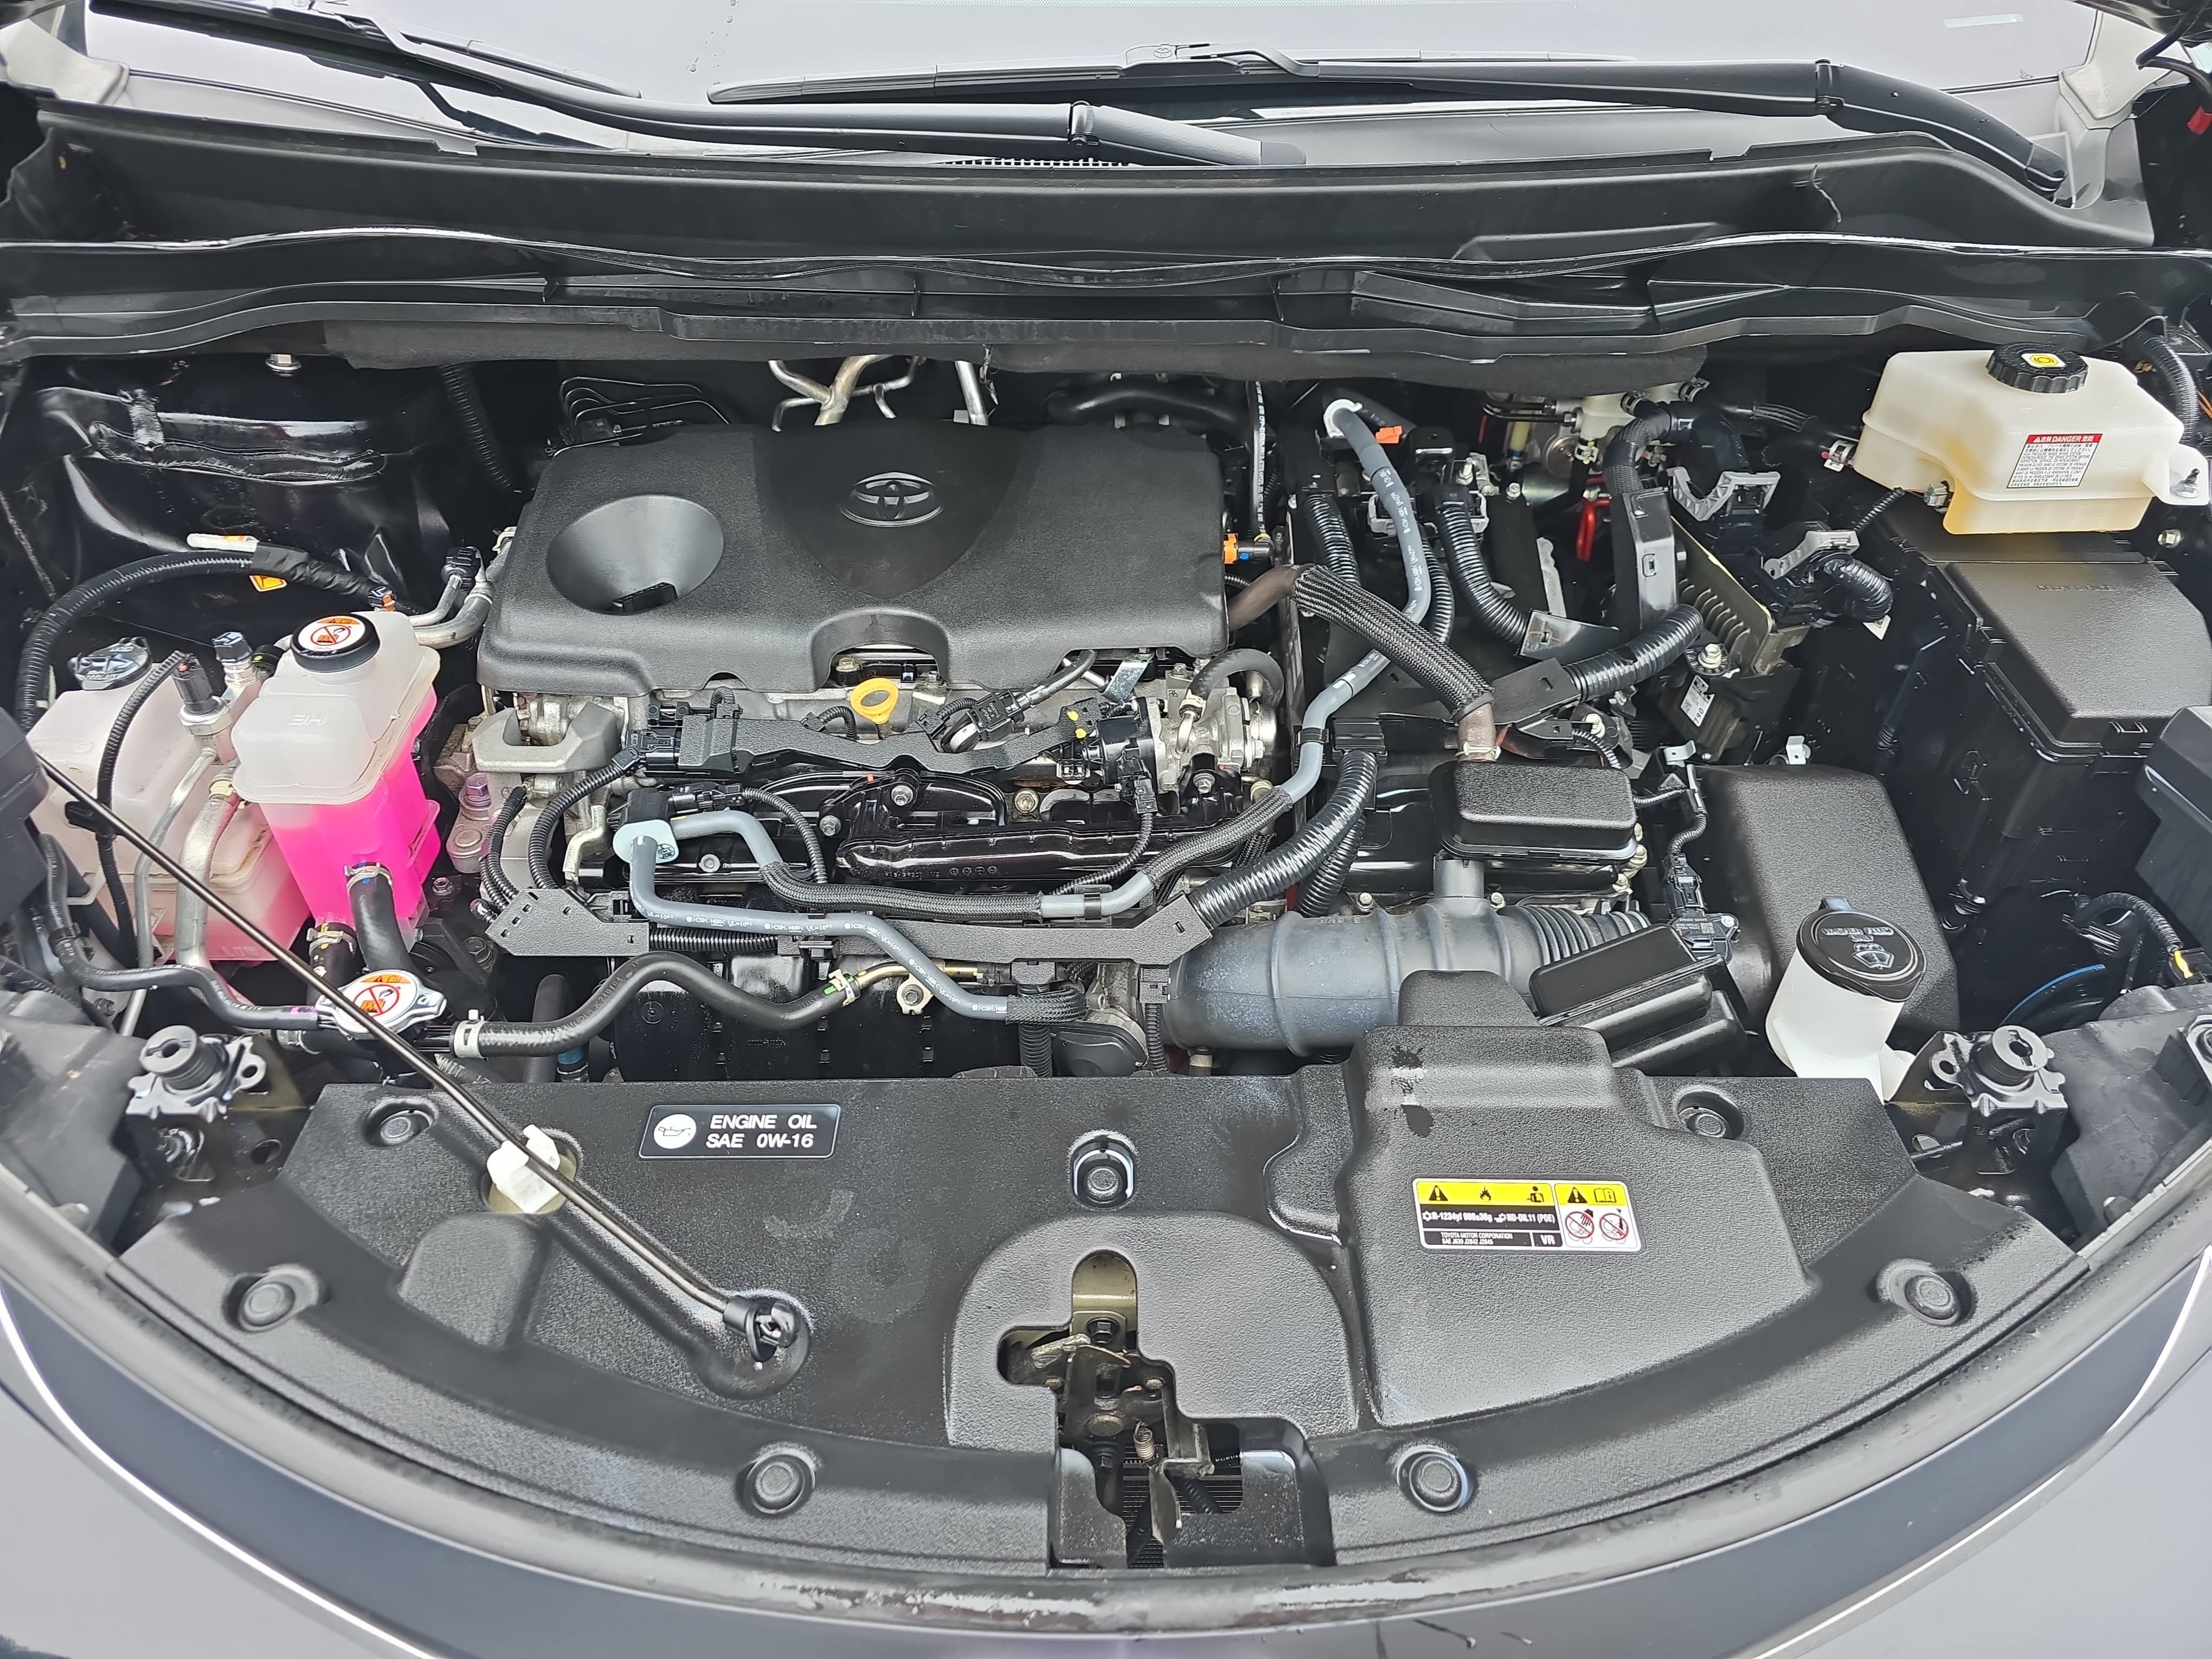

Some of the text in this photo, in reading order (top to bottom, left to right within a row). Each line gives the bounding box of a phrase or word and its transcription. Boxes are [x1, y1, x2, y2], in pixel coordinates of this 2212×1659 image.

[1821, 927, 1894, 935] WASHER FLUID
[1849, 934, 1874, 942] ONLY
[710, 1115, 817, 1129] ENGINE OIL
[706, 1133, 814, 1148] SAE 0W-16
[1432, 1211, 1462, 1222] R-1234yf
[1506, 1213, 1536, 1223] ND-OIL11
[1538, 1213, 1555, 1224] (POE)
[1540, 1234, 1555, 1245] VR
